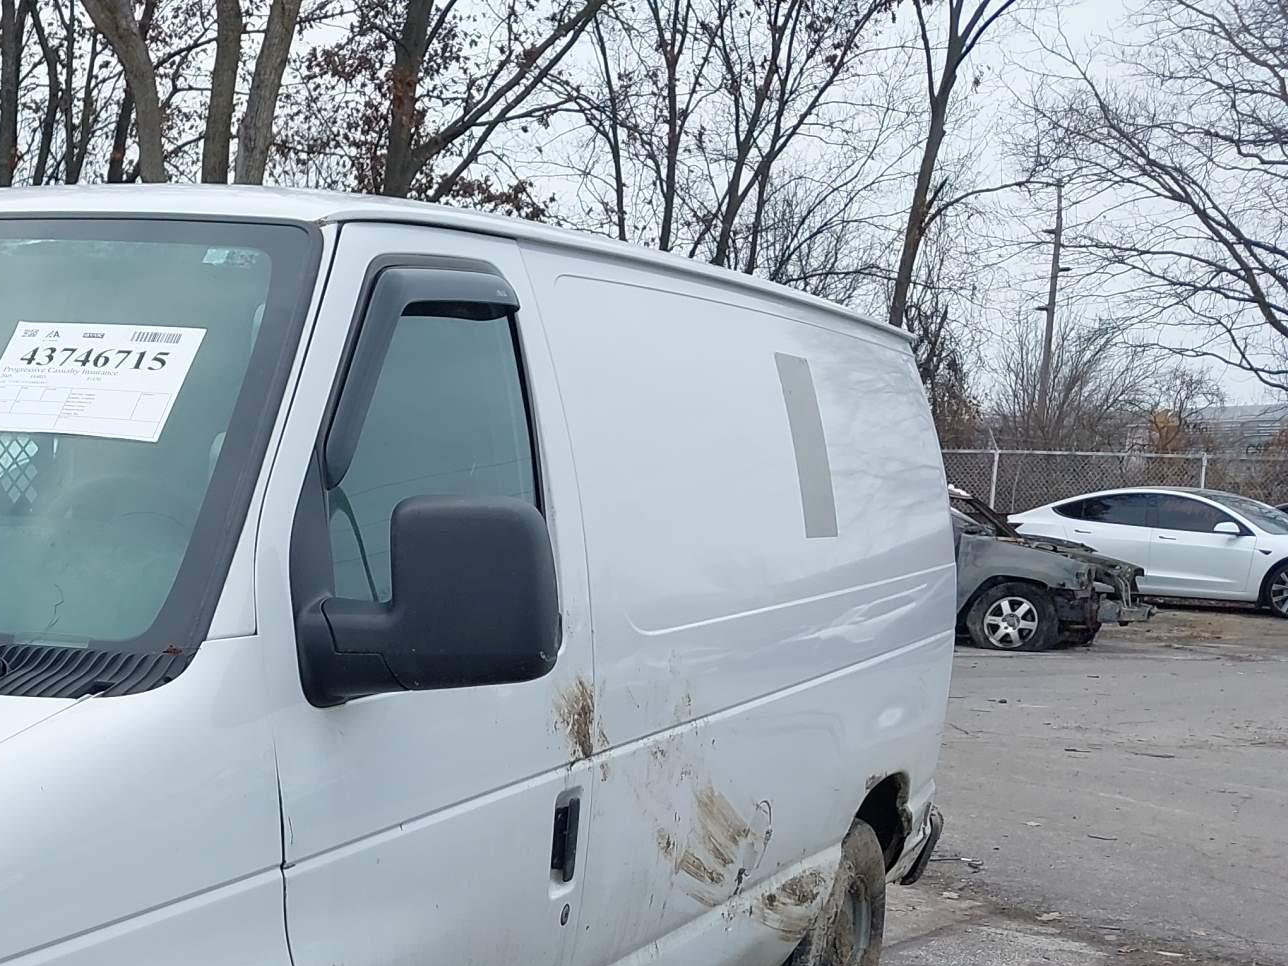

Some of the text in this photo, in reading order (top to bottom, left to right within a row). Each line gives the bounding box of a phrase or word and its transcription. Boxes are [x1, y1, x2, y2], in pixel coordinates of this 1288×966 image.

[20, 346, 170, 371] 43746715
[3, 366, 119, 376] Progressive Casualty Insurance
